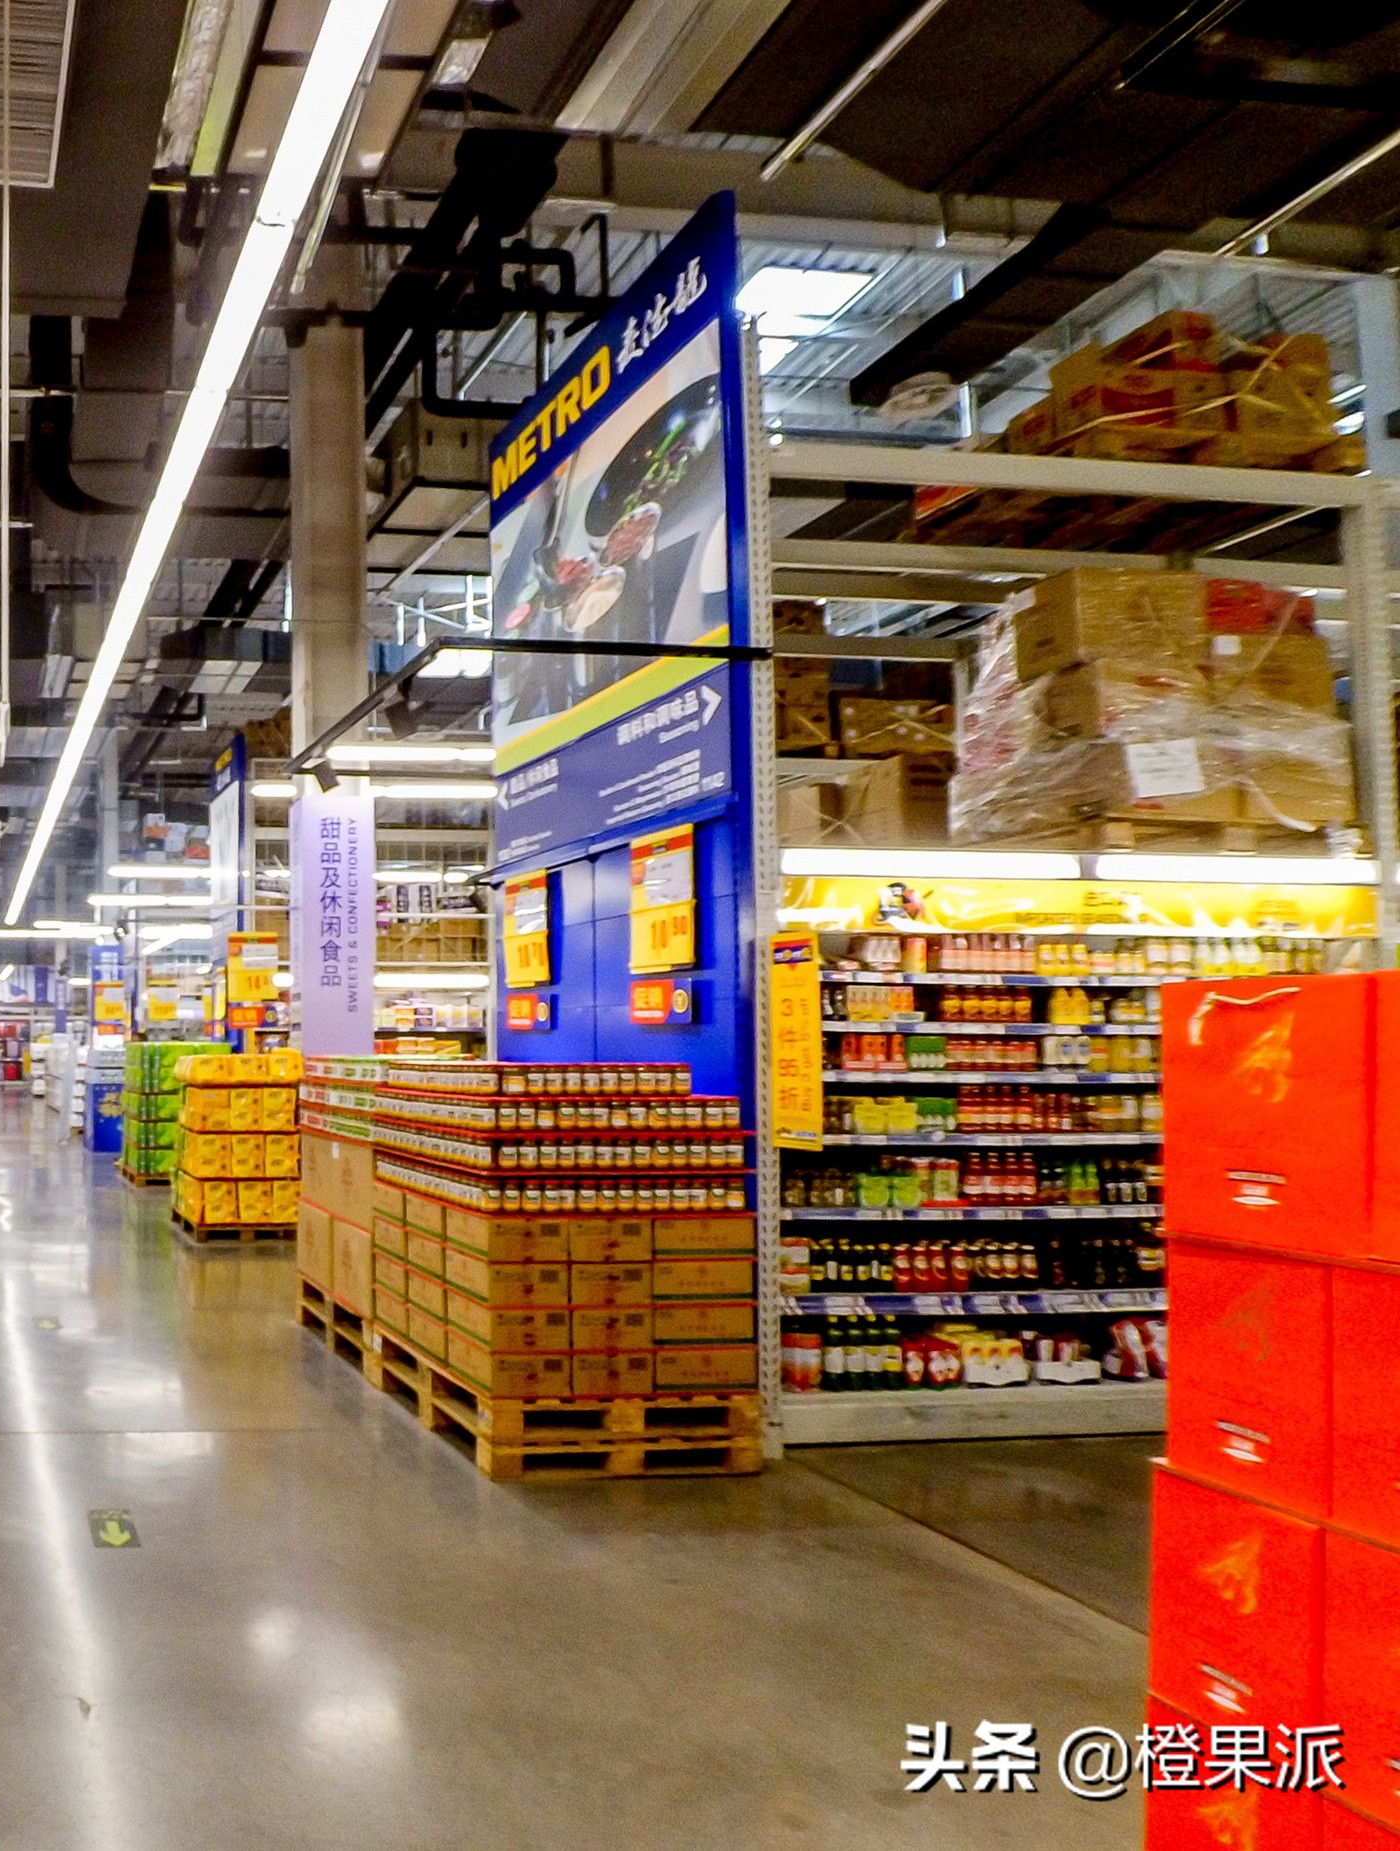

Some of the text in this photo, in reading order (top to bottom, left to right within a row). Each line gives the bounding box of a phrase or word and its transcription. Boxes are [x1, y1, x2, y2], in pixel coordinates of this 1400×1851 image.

[490, 345, 612, 500] METRO
[319, 816, 343, 987] 甜品及休闲食品
[348, 818, 359, 935] CONFECTIONERY
[348, 955, 359, 1013] SWEETS
